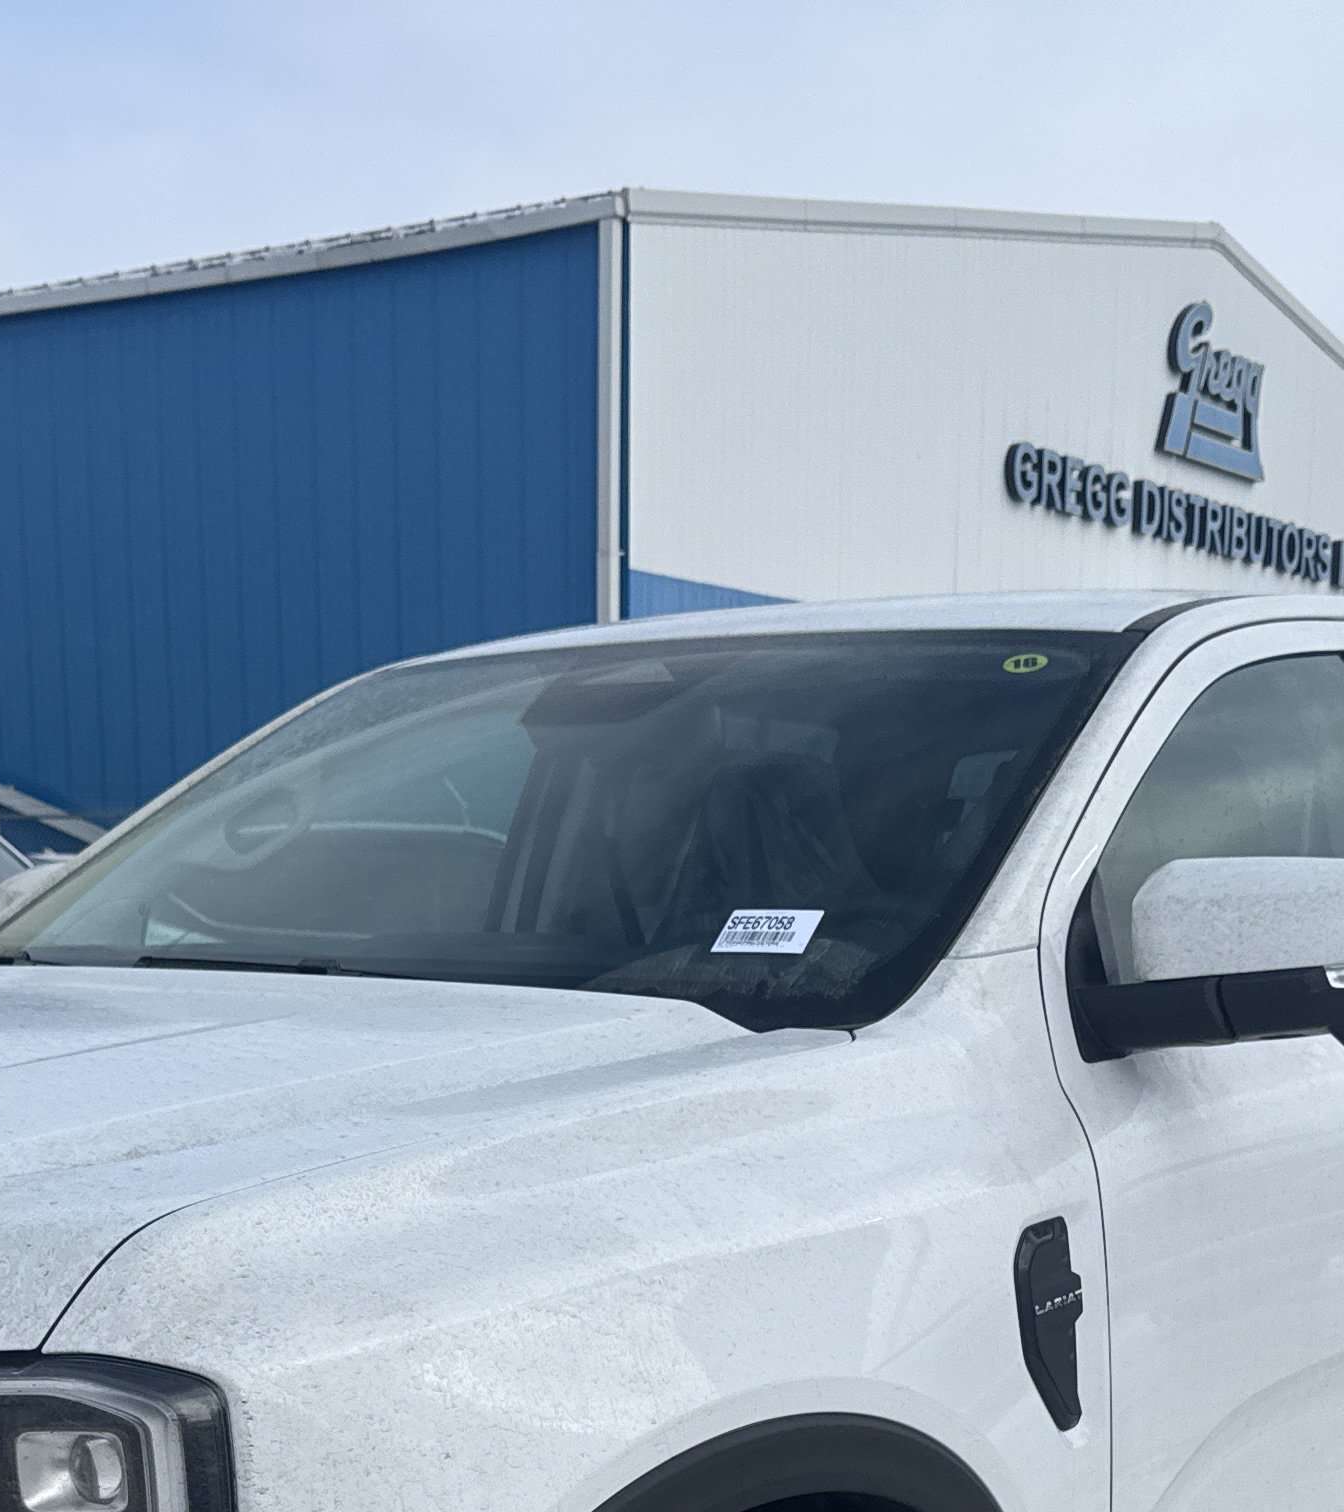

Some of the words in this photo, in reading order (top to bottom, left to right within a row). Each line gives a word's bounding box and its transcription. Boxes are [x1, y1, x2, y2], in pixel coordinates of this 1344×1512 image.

[1005, 441, 1131, 529] GREGG
[1132, 478, 1332, 584] DISTRIBUTORS
[727, 915, 796, 931] SFE67058
